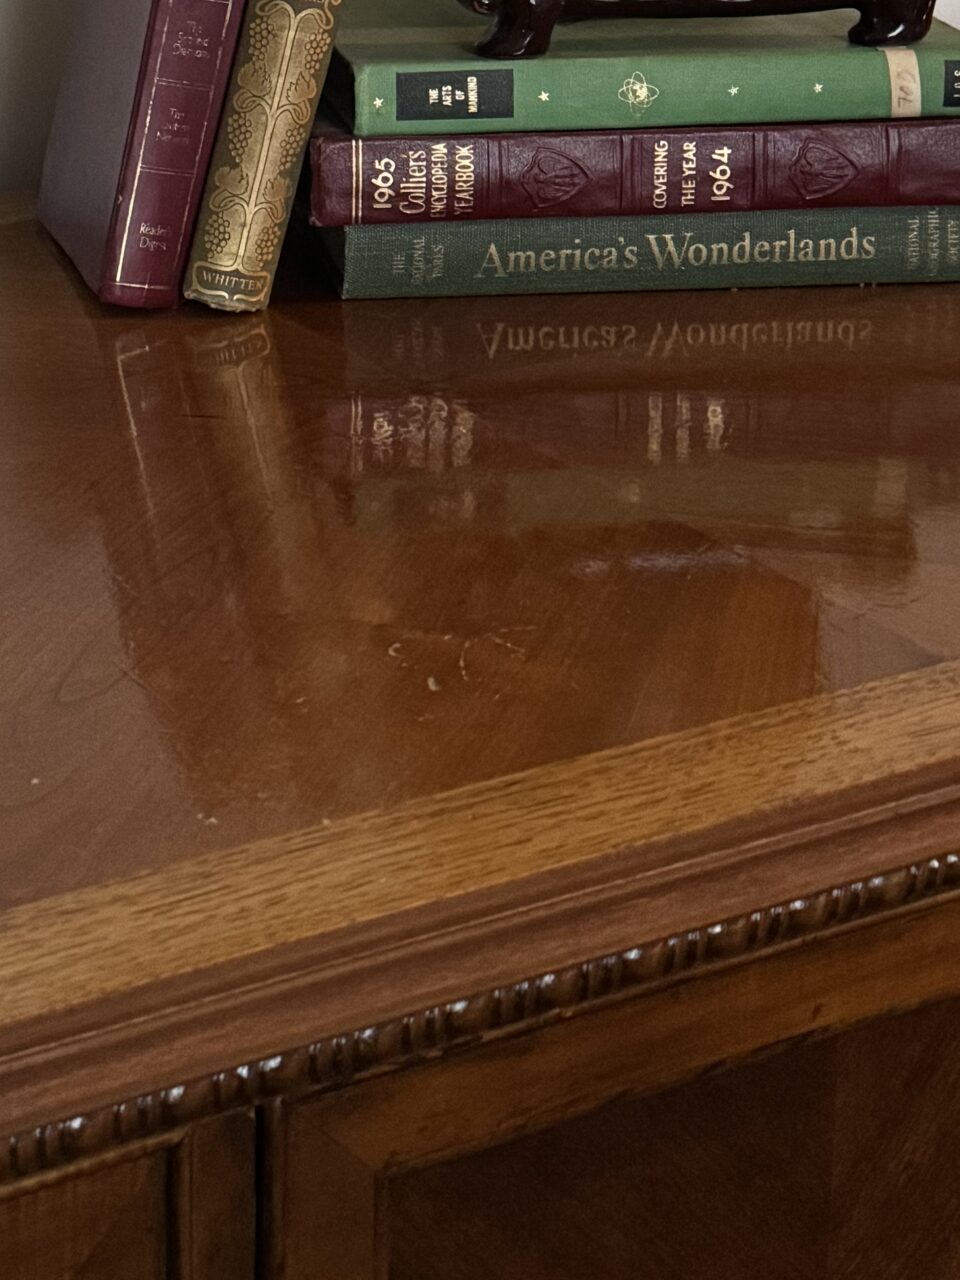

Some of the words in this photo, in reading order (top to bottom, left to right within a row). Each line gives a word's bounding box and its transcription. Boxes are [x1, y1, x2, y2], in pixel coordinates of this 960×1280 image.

[428, 87, 440, 105] THE
[441, 84, 453, 107] ARTS
[454, 89, 466, 101] OF
[466, 75, 478, 114] MANKIND
[430, 142, 448, 218] ENCYCLOPEDIA
[453, 144, 475, 215] YEARBOOK
[653, 140, 669, 209] COVERING
[682, 141, 697, 177] YEAR
[709, 146, 734, 201] 1964
[371, 157, 396, 209] 1965
[399, 150, 427, 215] Collier's
[681, 179, 696, 207] THE
[472, 237, 638, 278] America's
[644, 226, 876, 271] Wonderlands
[202, 270, 265, 291] WHITTEN
